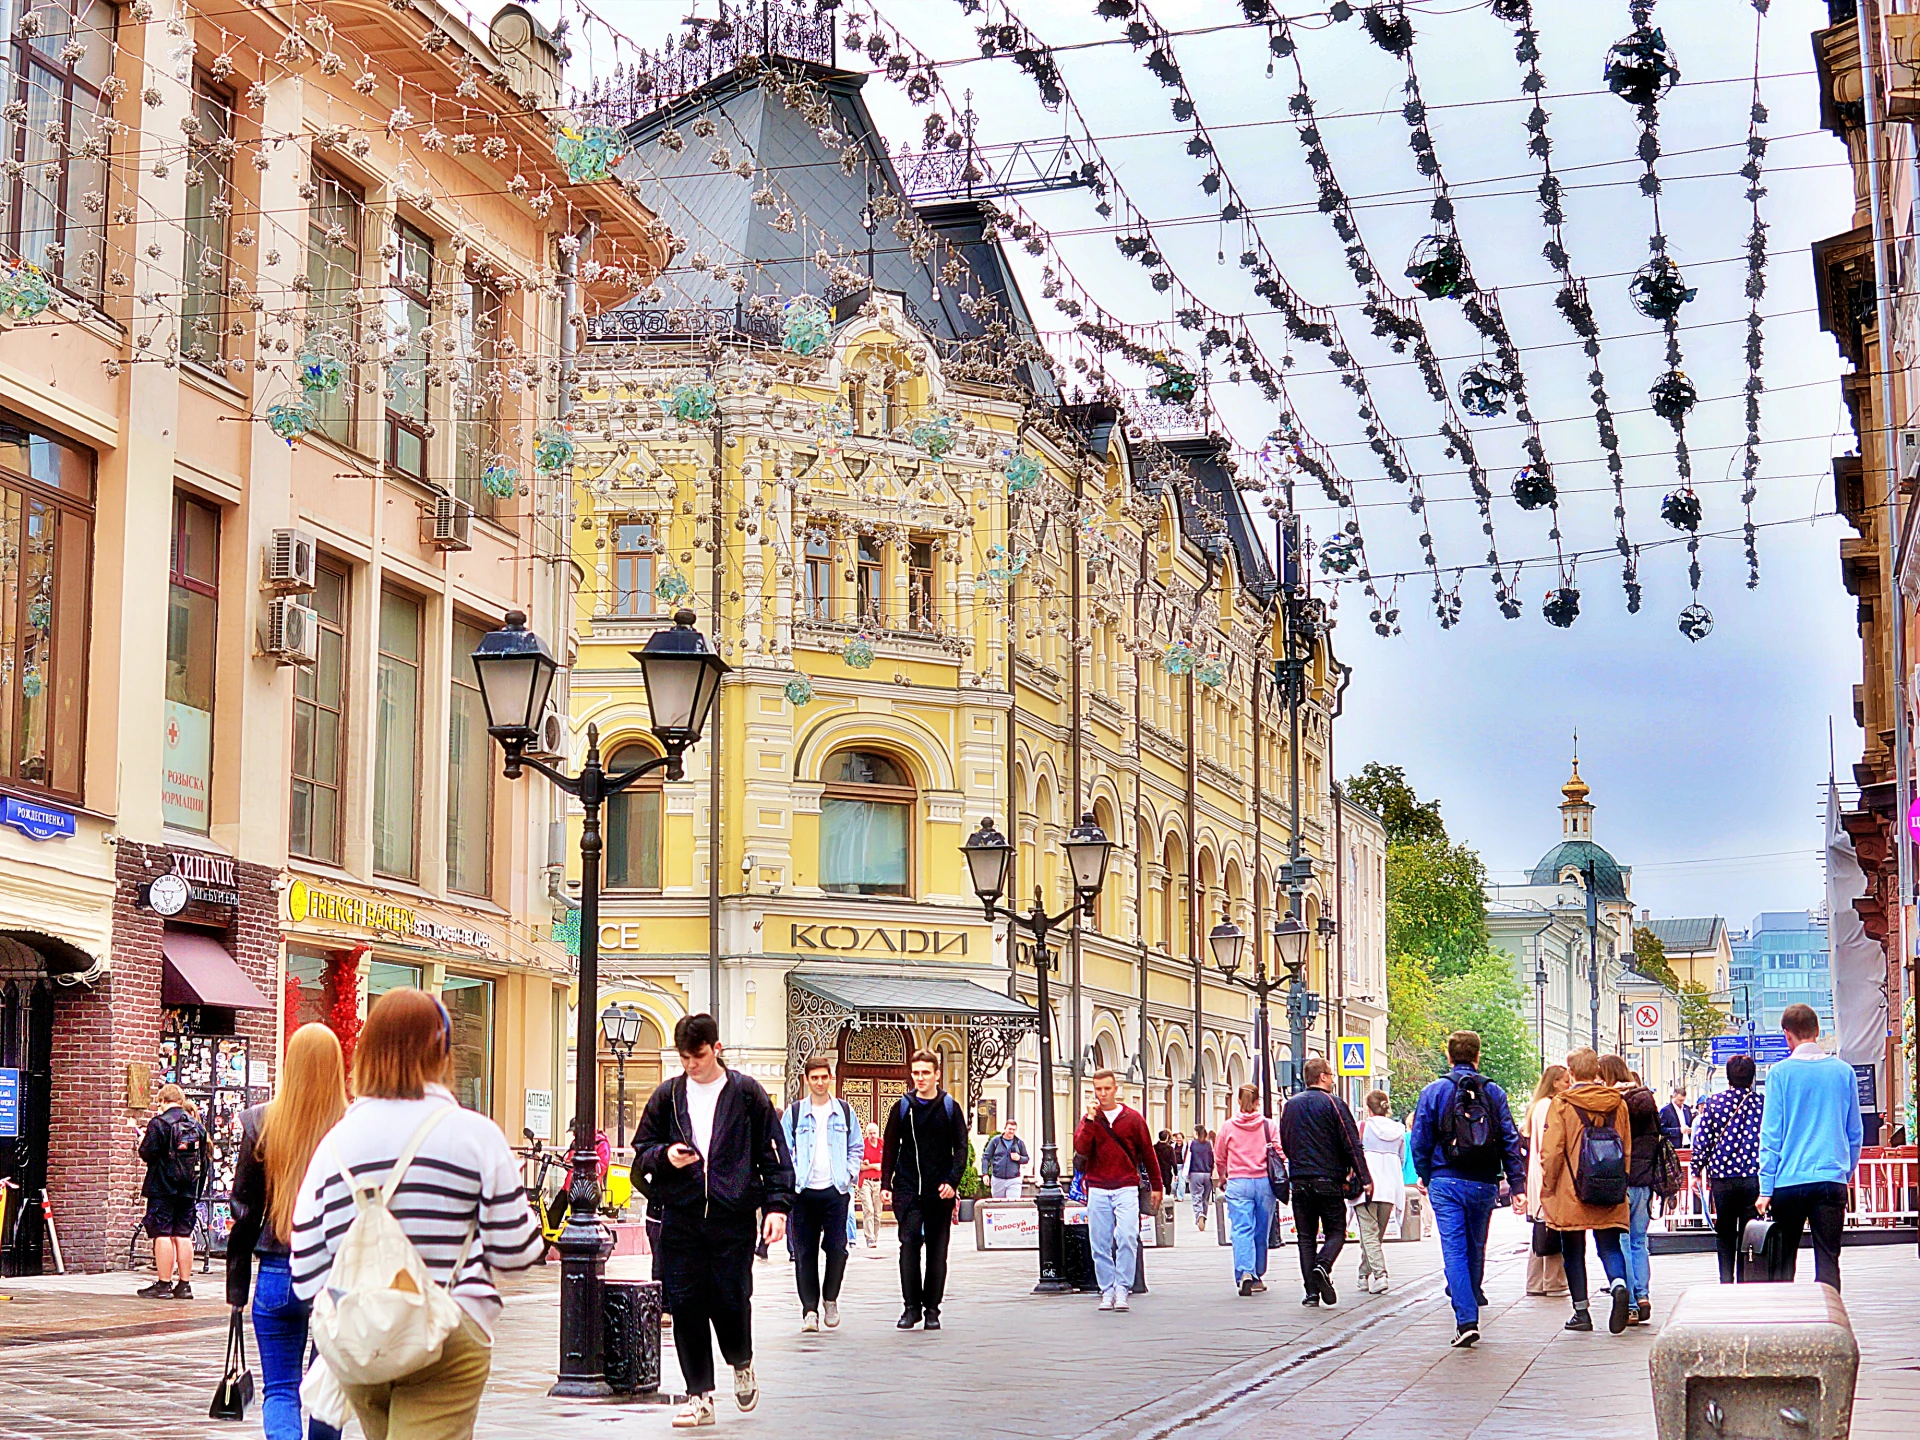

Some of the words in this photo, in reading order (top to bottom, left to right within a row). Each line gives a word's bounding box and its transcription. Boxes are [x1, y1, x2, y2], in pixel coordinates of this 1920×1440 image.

[168, 769, 204, 791] РОЗЫСКА
[17, 806, 65, 827] РОЖДЕСТВЕНКА
[153, 901, 182, 913] BURGERS
[208, 889, 240, 906] БУРГЕРЫ
[309, 890, 363, 925] FRENCH
[366, 902, 416, 934] BAKERY
[791, 923, 968, 955] КОЛДИ
[527, 1092, 551, 1107] АПТЕКА
[993, 1219, 1027, 1232] Голосуй
